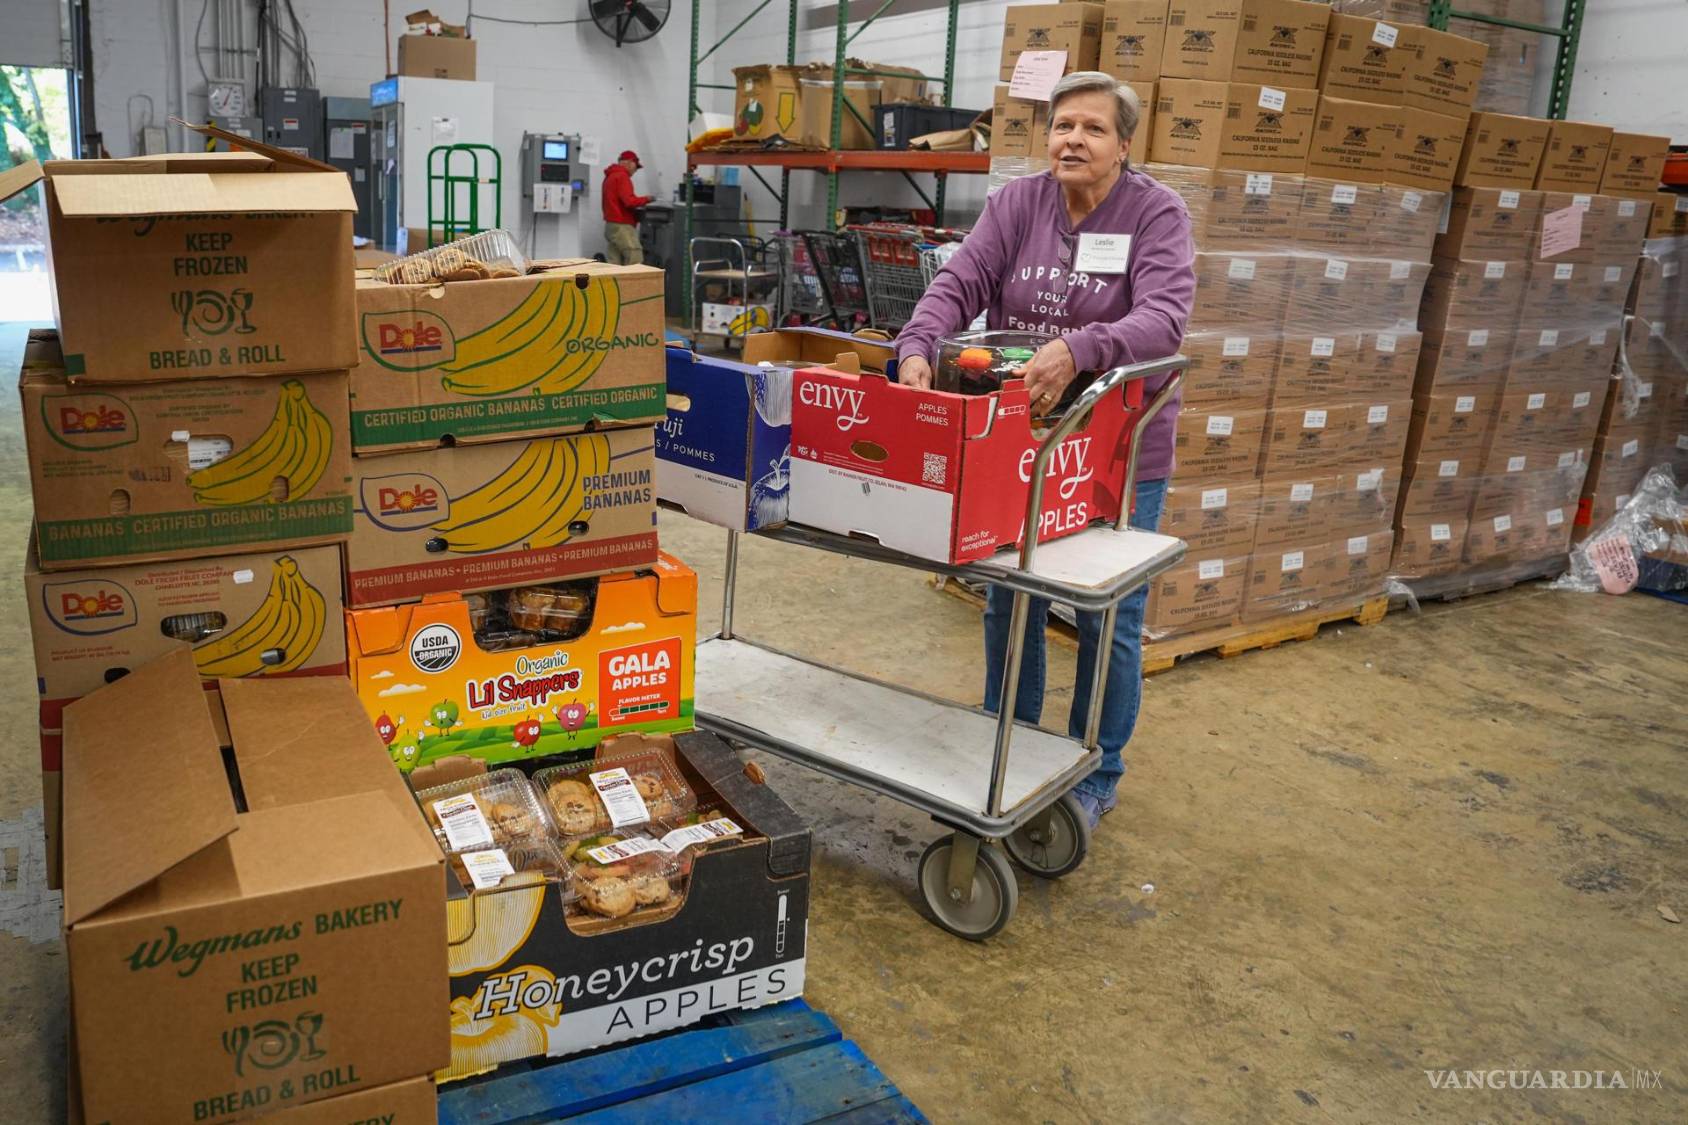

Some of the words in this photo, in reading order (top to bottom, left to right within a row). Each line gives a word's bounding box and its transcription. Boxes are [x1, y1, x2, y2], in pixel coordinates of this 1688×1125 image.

[186, 233, 233, 252] KEEP
[1094, 238, 1114, 246] Leslie
[173, 256, 248, 276] FROZEN
[1011, 266, 1108, 294] UPPORT
[1031, 304, 1069, 317] LOCAL
[1037, 291, 1068, 304] YOUR
[379, 321, 442, 349] Dole
[1008, 316, 1046, 333] Food
[1050, 324, 1084, 337] Ban
[566, 333, 659, 354] ORGANIC
[150, 348, 212, 370] BREAD
[218, 348, 233, 363] &
[238, 345, 286, 363] ROLL
[60, 404, 127, 431] Dole
[364, 406, 427, 428] CERTIFIED
[430, 402, 484, 423] ORGANIC
[487, 398, 546, 416] BANANAS
[551, 392, 608, 410] CERTIFIED
[610, 387, 658, 404] ORGANIC
[799, 380, 870, 431] envy
[918, 403, 948, 415] APPLES
[655, 417, 684, 438] uji
[916, 412, 949, 426] POMMES
[673, 443, 716, 462] POMMES
[583, 469, 651, 492] PREMIUM
[379, 484, 438, 511] Dole
[583, 488, 651, 511] BANANAS
[50, 521, 125, 542] BANANAS
[133, 514, 207, 534] CERTIFIED
[211, 508, 274, 528] ORGANIC
[279, 500, 346, 521] BANANAS
[1016, 502, 1087, 543] PLES
[354, 573, 404, 589] PREMIUM
[406, 567, 455, 583] BANANAS
[463, 559, 509, 575] PREMIUM
[564, 545, 608, 561] PREMIUM
[610, 539, 653, 556] BANANAS
[61, 590, 124, 616] Dole
[419, 649, 452, 660] ORGANIC
[422, 635, 449, 648] USDA
[516, 650, 568, 676] Organic
[608, 650, 671, 677] GALA
[497, 671, 580, 706] Snappers
[612, 672, 667, 691] APPLES
[618, 696, 640, 704] FLAVOR
[641, 693, 661, 701] METER
[124, 921, 303, 978] Wegmans
[315, 899, 403, 935] BAKERY
[241, 953, 300, 983] KEEP
[475, 934, 754, 1020] Honeycrisp
[226, 976, 318, 1013] FROZEN
[606, 968, 787, 1034] APPLES
[194, 1085, 272, 1122] BREAD
[279, 1080, 295, 1099] &
[304, 1065, 361, 1093] ROLL
